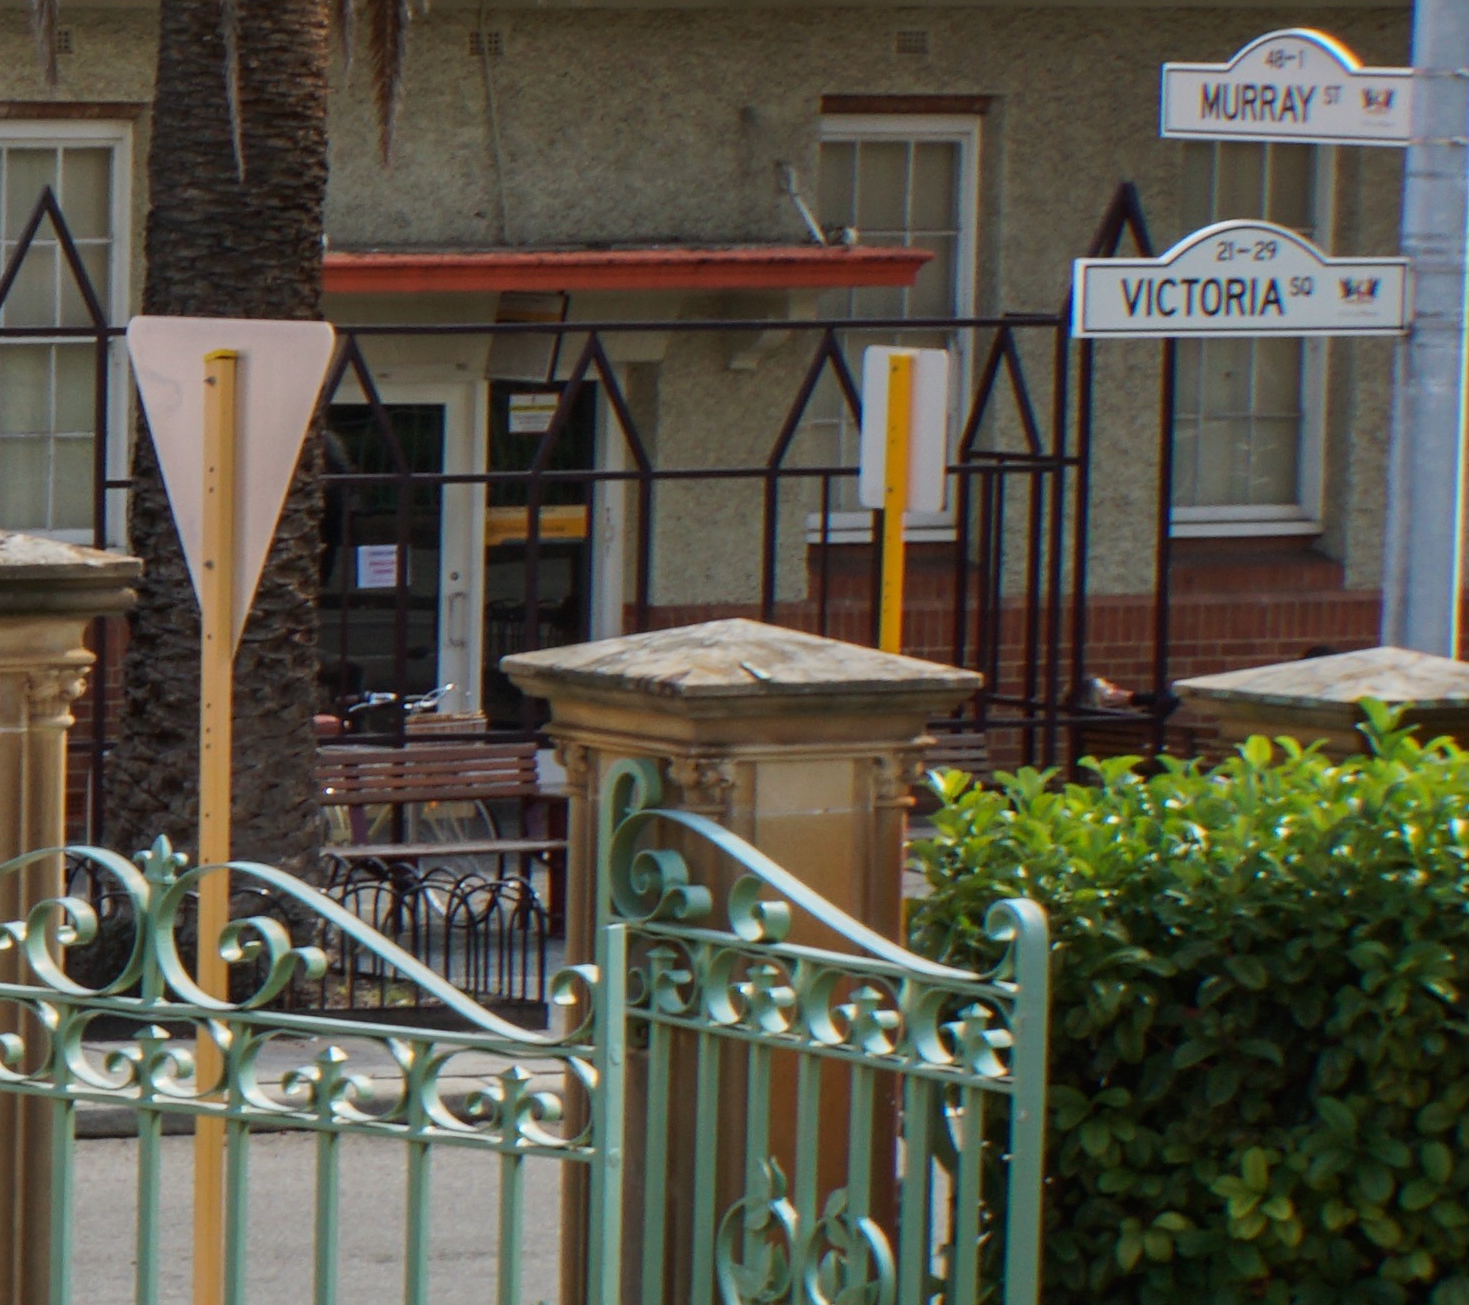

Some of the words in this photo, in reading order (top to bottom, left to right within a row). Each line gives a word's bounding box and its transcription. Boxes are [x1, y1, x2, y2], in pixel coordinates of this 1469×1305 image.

[1199, 83, 1317, 123] MURRAY
[1323, 85, 1343, 105] ST
[1120, 278, 1285, 317] VICTORIA
[1289, 277, 1313, 297] SQ
